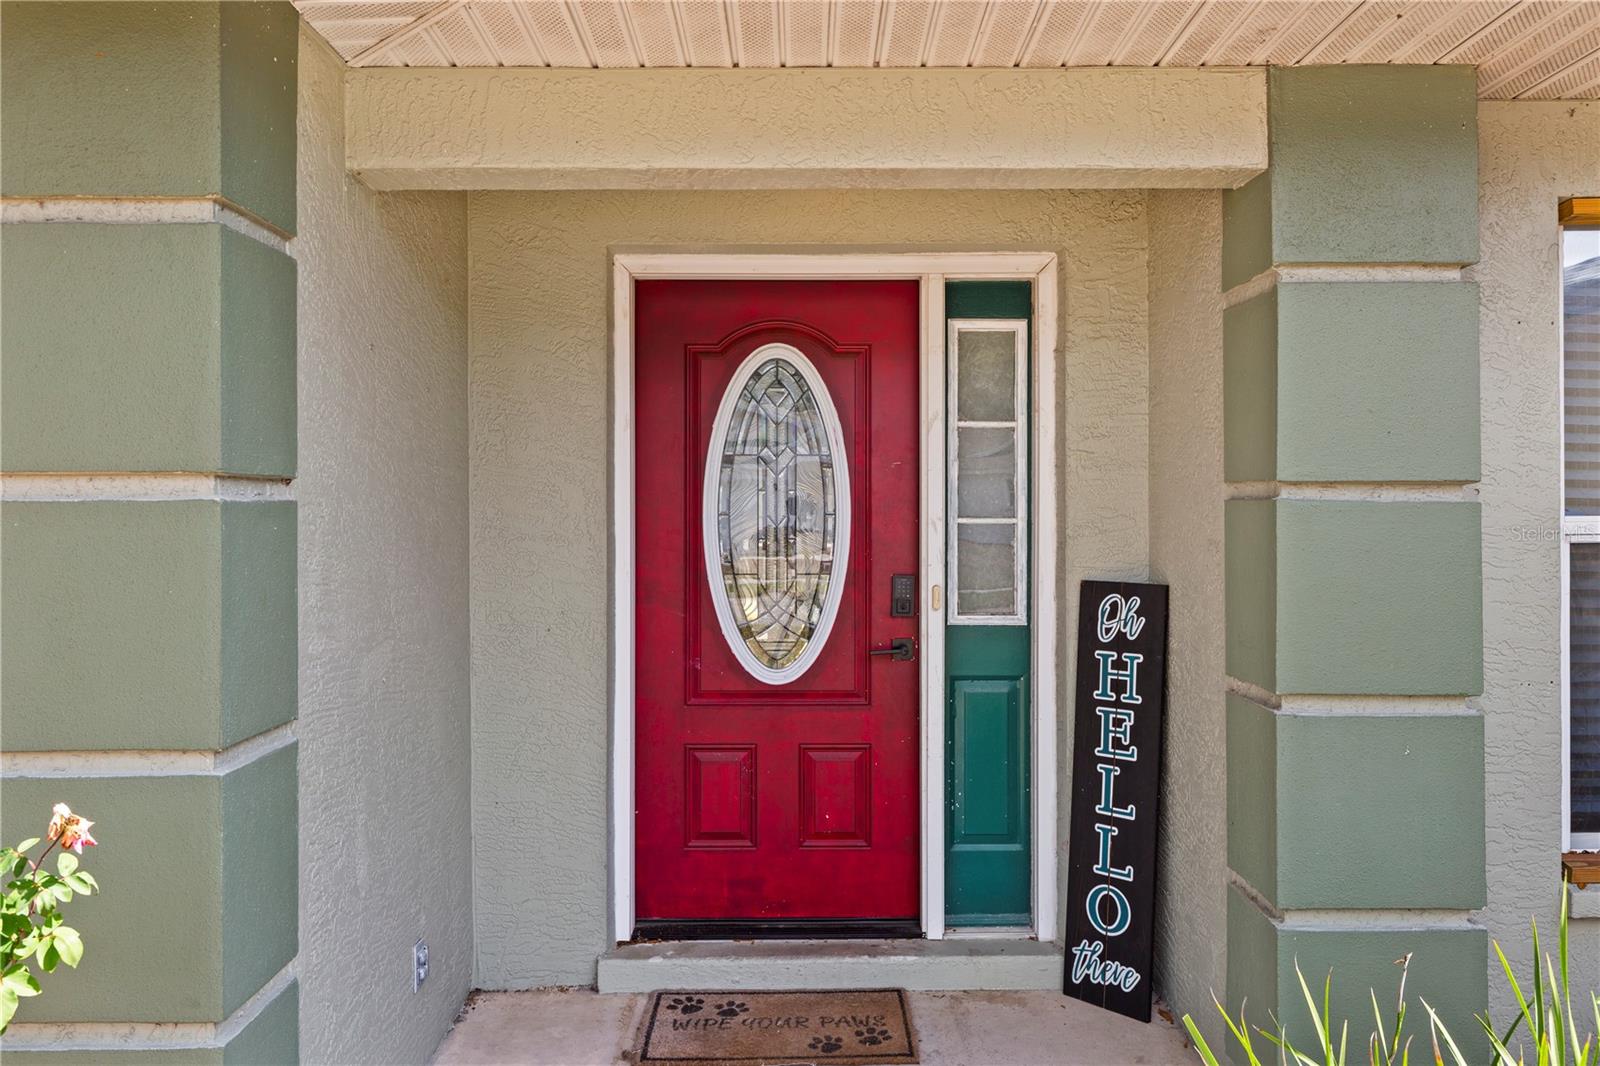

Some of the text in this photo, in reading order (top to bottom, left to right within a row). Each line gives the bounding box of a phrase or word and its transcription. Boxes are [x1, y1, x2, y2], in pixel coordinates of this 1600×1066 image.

[1097, 593, 1145, 643] Oh
[1085, 650, 1144, 937] HELLO
[1071, 939, 1141, 993] there
[672, 1015, 886, 1031] WIPE YOUR PAWS
